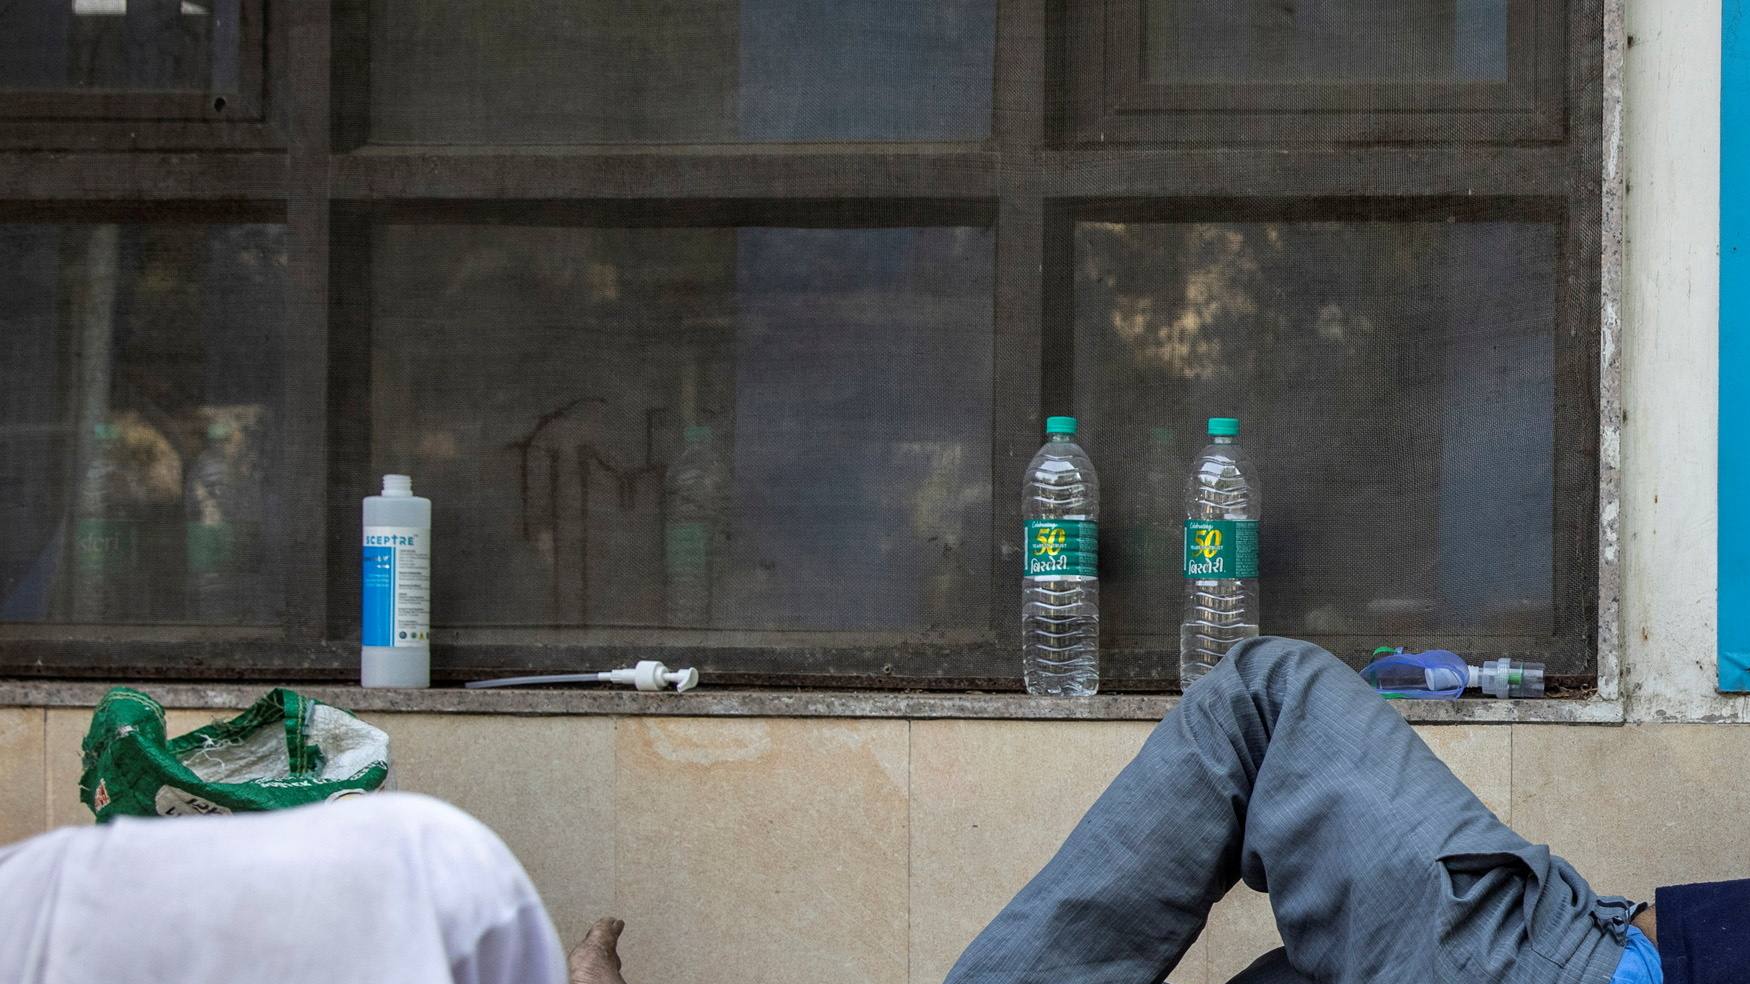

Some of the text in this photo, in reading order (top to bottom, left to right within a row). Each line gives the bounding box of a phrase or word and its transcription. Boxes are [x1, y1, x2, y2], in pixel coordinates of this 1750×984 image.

[366, 534, 415, 546] SCEPTRE
[1033, 527, 1066, 556] 50
[1192, 528, 1222, 558] 50
